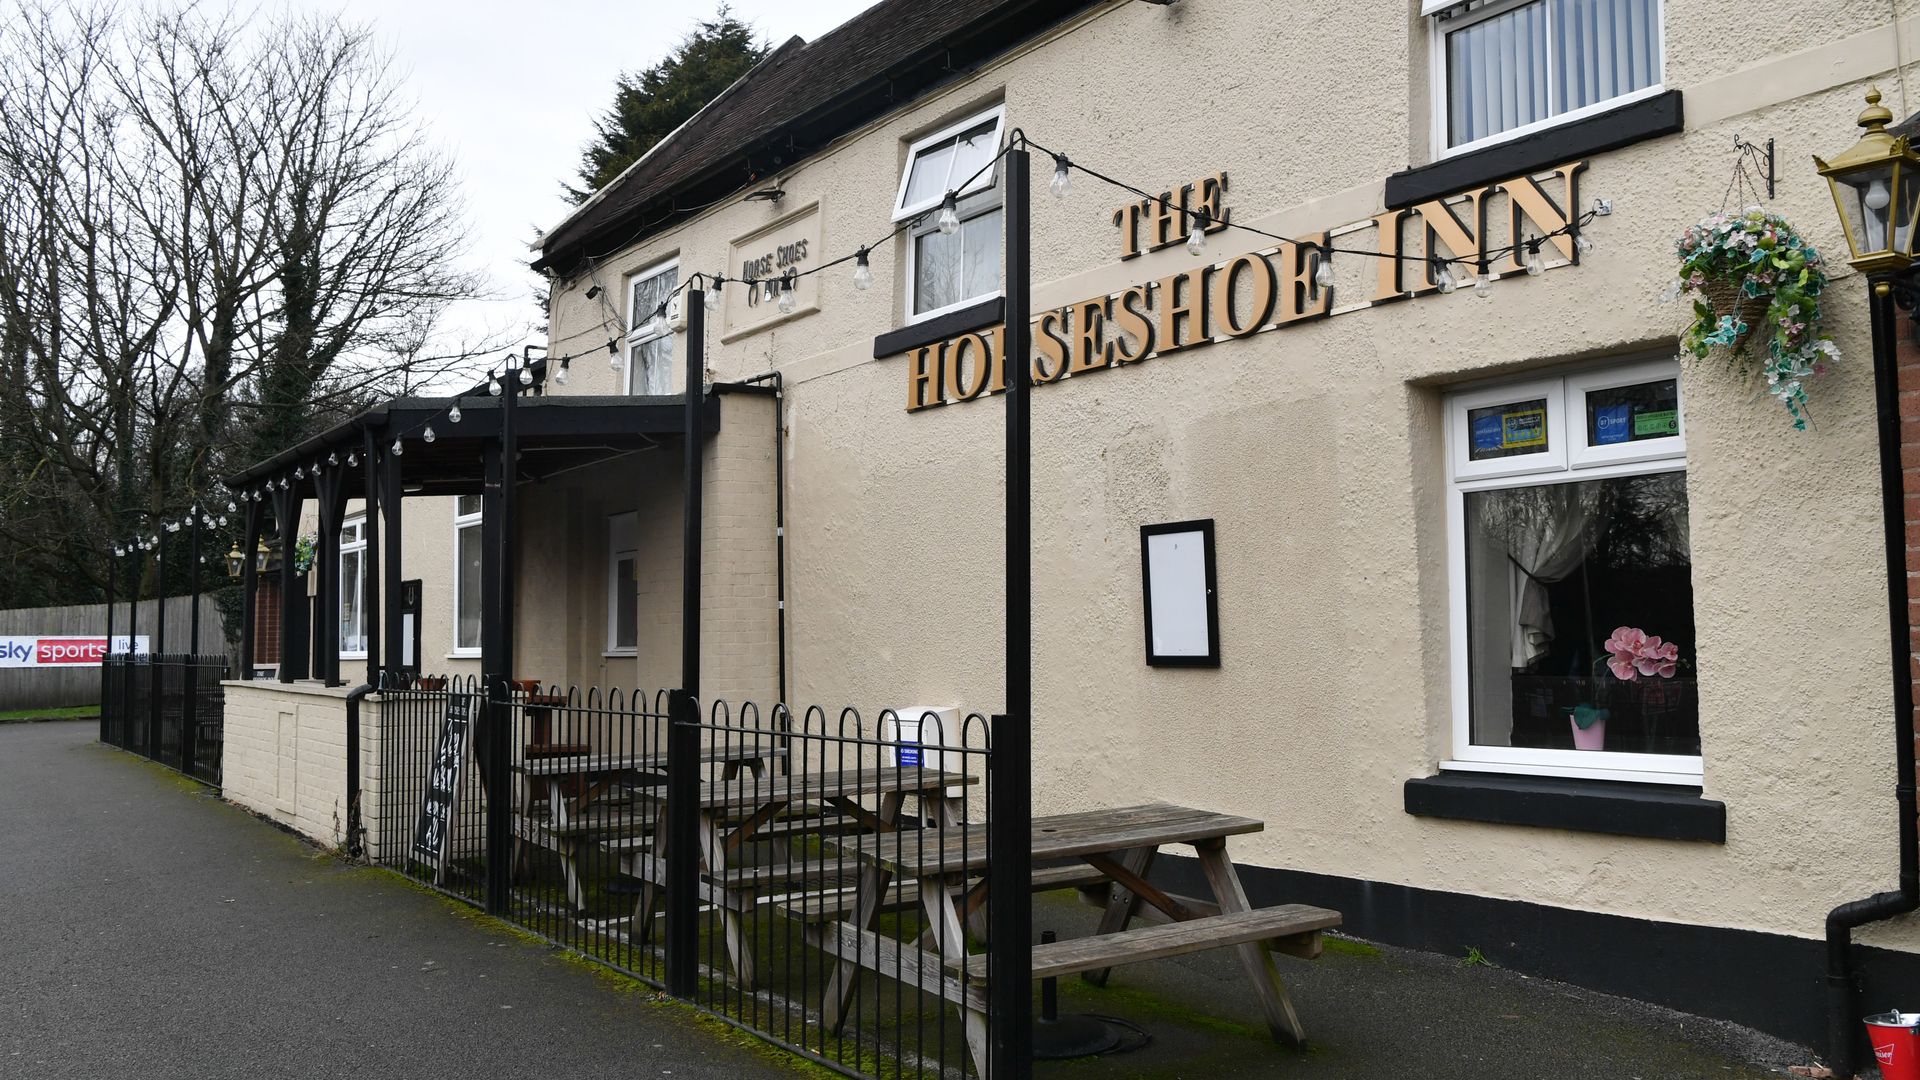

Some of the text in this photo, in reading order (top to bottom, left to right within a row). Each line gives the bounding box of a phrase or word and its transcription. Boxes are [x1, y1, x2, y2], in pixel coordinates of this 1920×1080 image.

[1113, 171, 1228, 261] THE
[1371, 160, 1589, 301] INN
[743, 238, 808, 281] HORSE SHOES
[1610, 417, 1626, 425] SPORT
[0, 641, 32, 662] sky
[41, 643, 107, 661] sports
